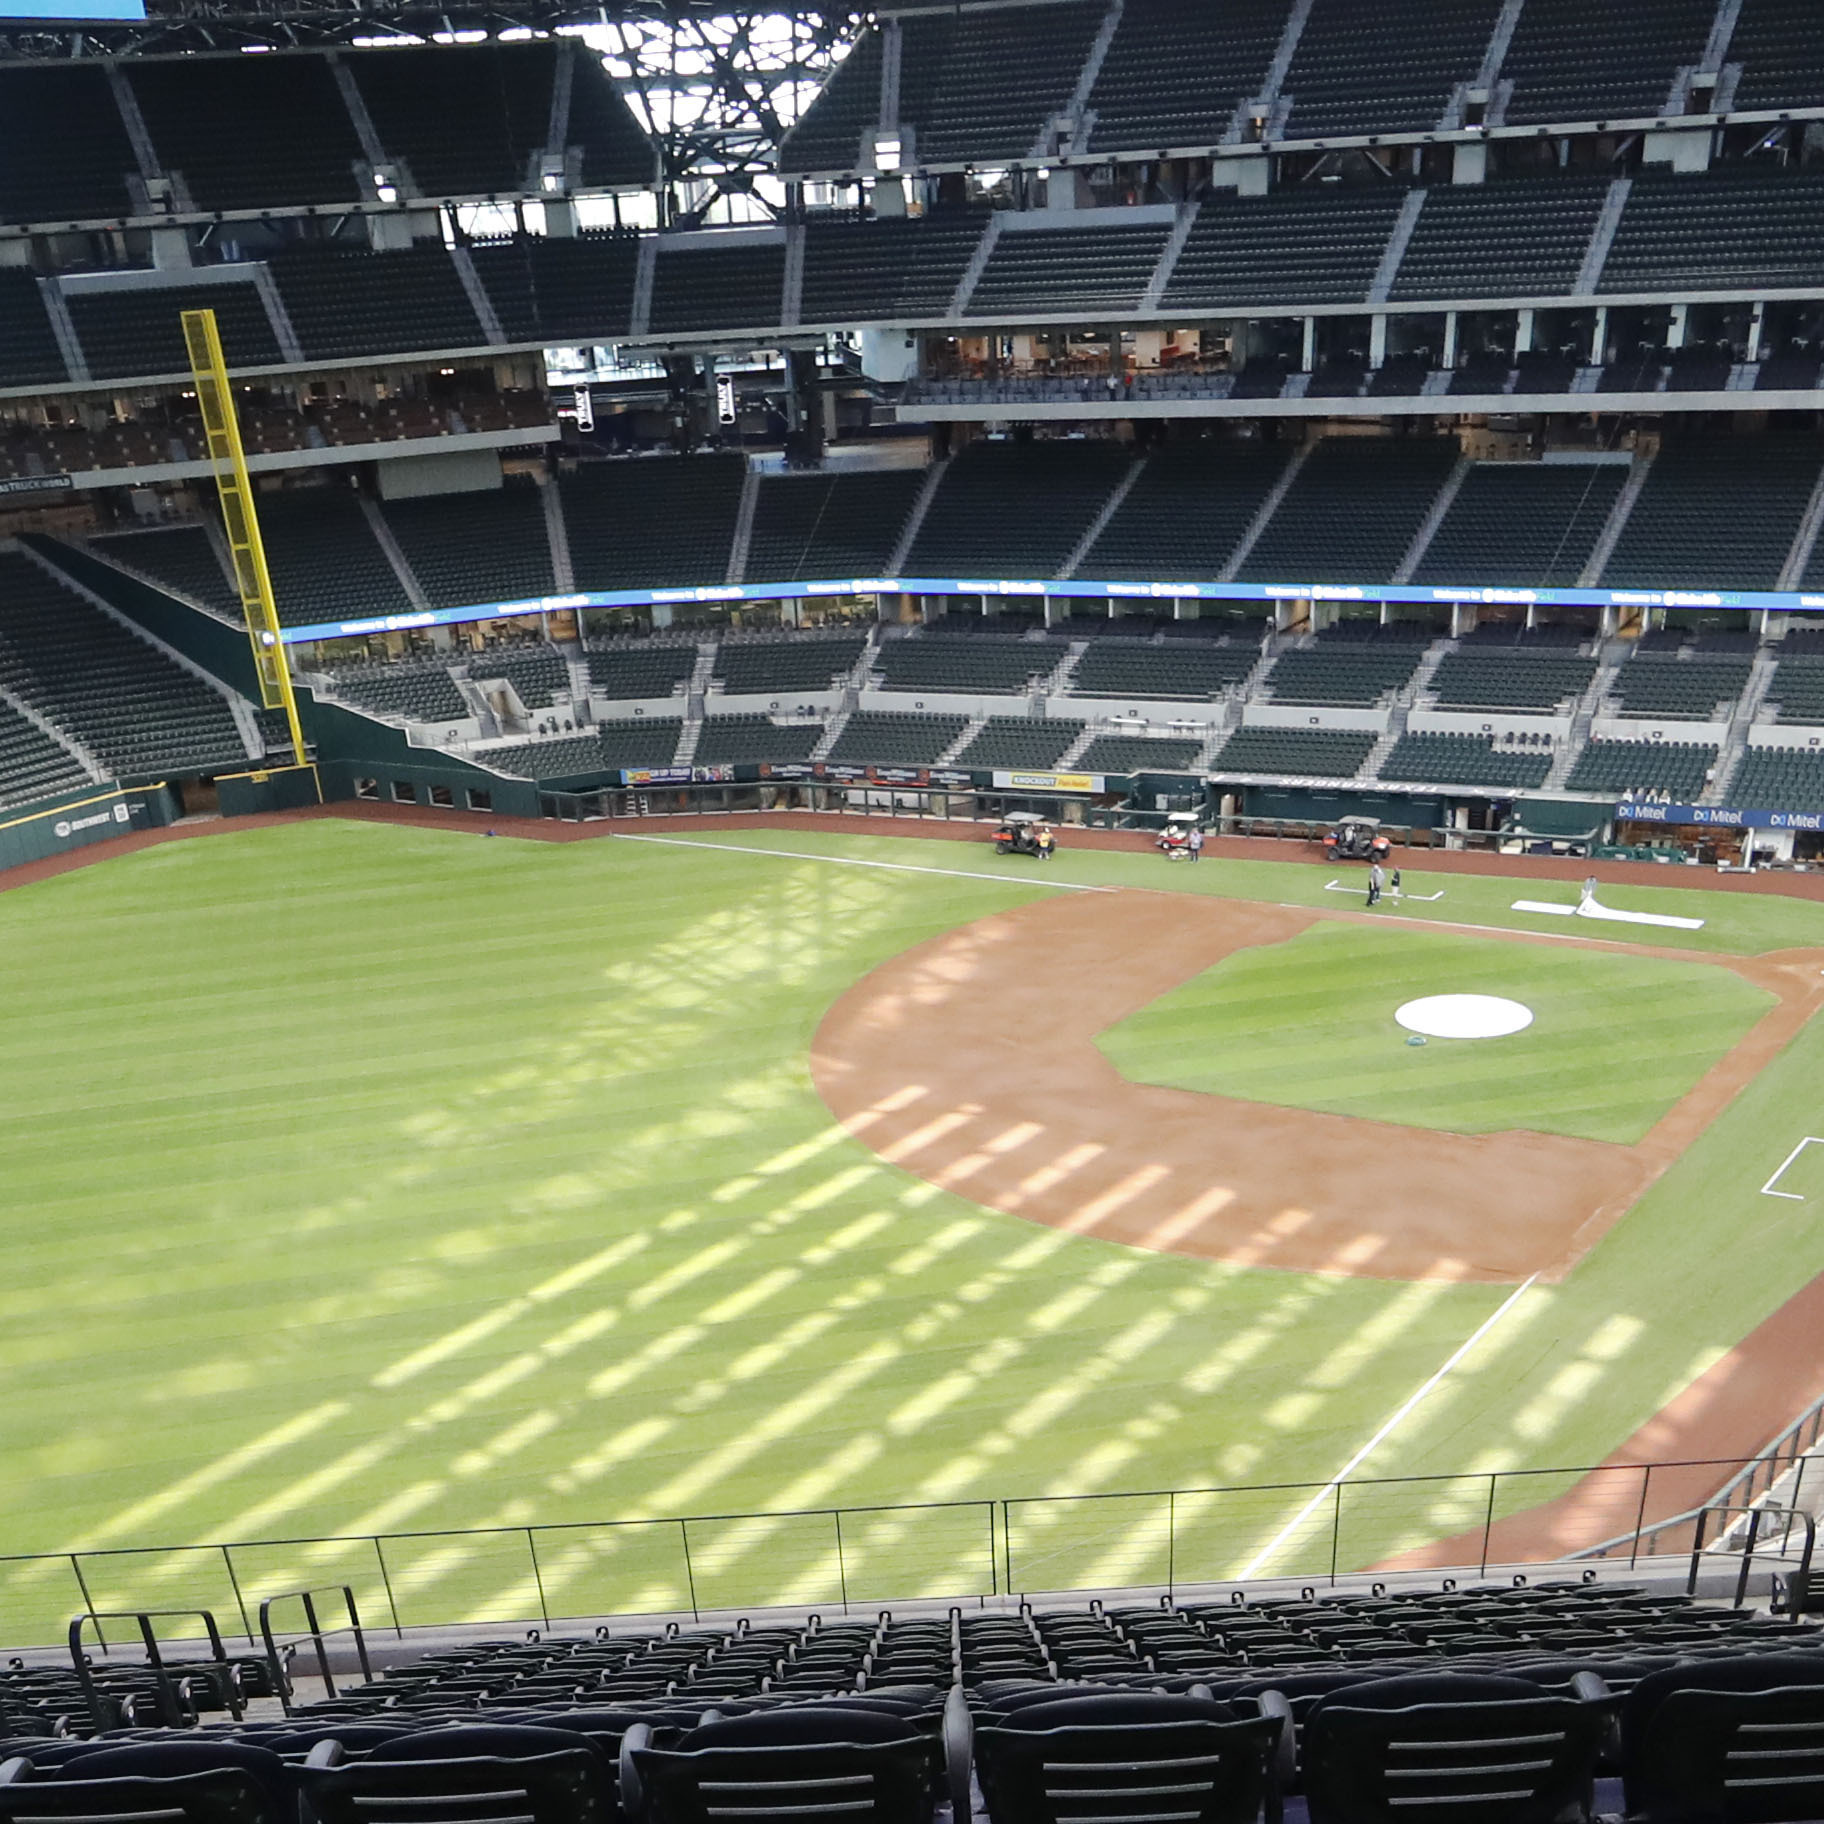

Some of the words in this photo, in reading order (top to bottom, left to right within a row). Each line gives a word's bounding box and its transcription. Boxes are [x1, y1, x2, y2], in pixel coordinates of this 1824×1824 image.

[1635, 805, 1667, 821] Mitel
[1710, 810, 1743, 824] Mitel
[1787, 814, 1822, 829] Mitel
